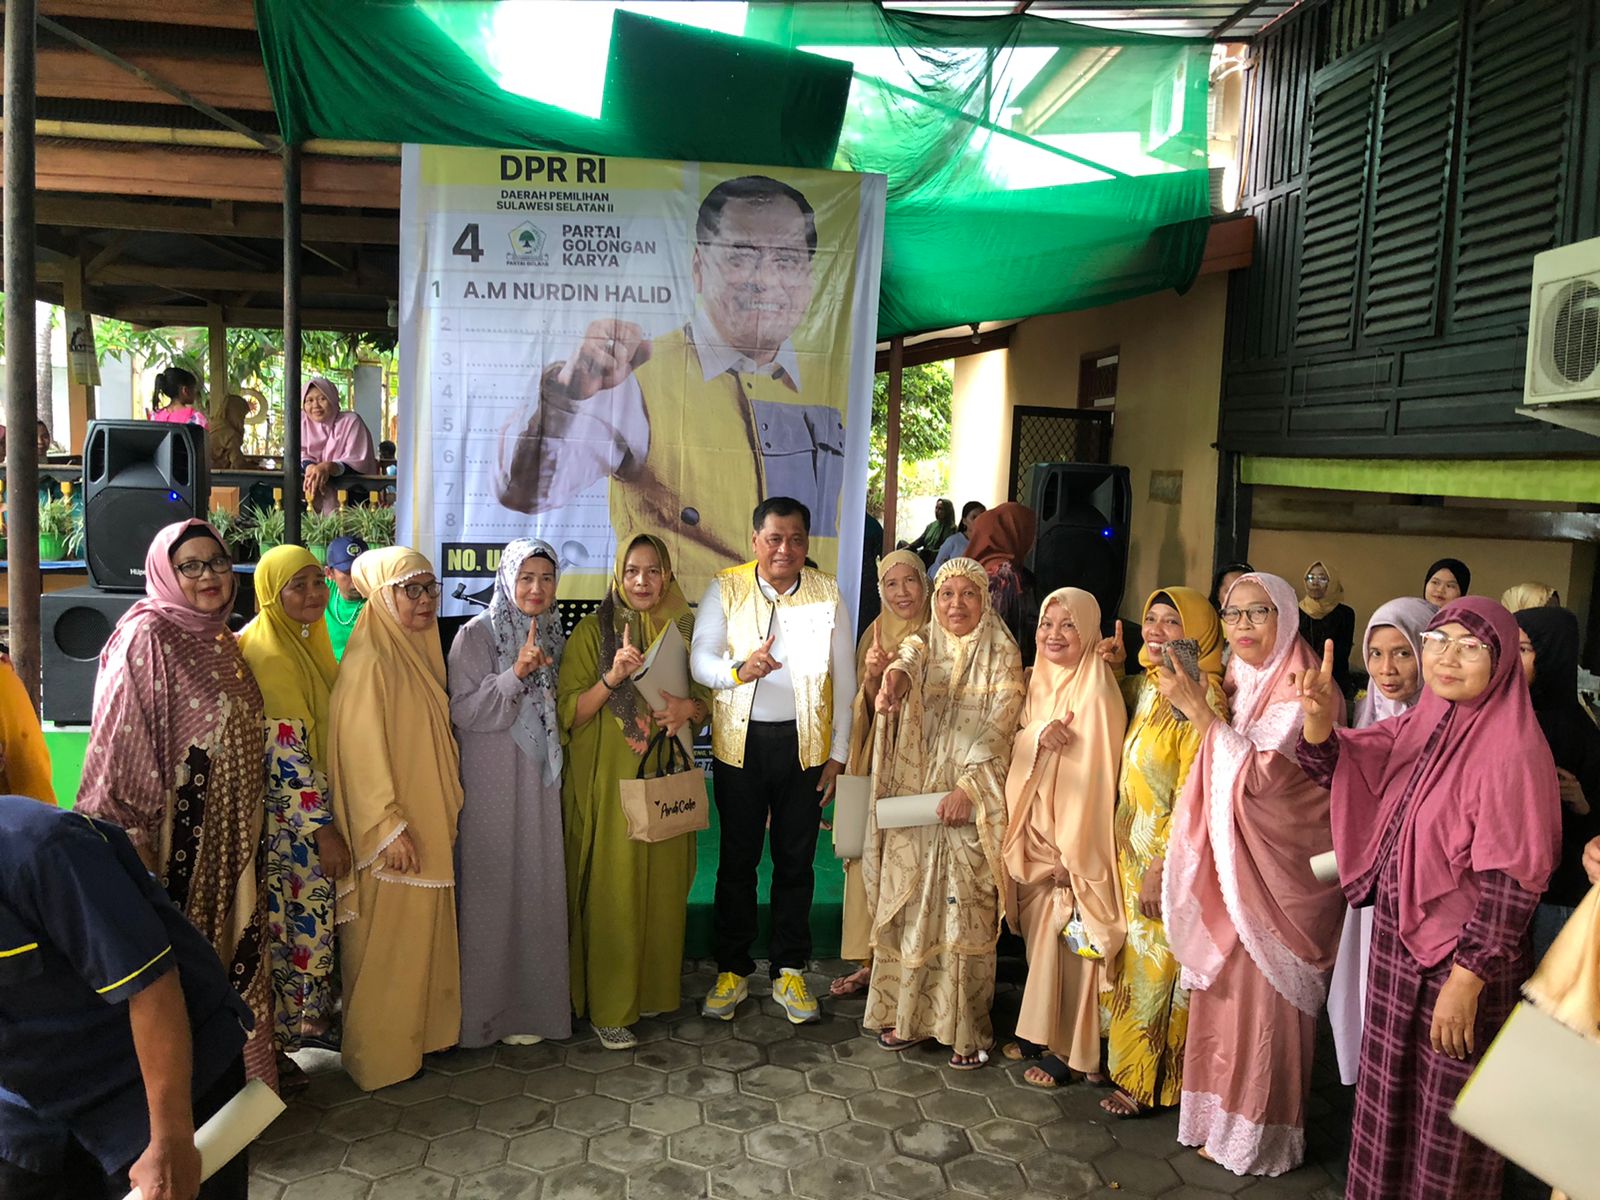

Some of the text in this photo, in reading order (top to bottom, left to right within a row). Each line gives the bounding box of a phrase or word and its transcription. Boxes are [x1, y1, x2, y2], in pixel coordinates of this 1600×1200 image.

[500, 155, 606, 184] DPR RI
[500, 190, 609, 202] DAERAH PEMILIHAN
[496, 200, 614, 213] SULAWESI SELATAN II
[562, 224, 621, 239] PARTAI
[452, 223, 484, 263] 4
[562, 239, 657, 255] GOLONGAN
[562, 253, 620, 267] KARYA
[431, 280, 672, 304] 1 A.M NURDIN HALID
[440, 316, 452, 331] 2
[441, 352, 453, 367] 3
[442, 384, 454, 399] 4
[442, 417, 454, 432] 5
[443, 450, 455, 464] 6
[443, 482, 456, 497] 7
[445, 512, 457, 528] 8
[447, 548, 482, 572] NO.
